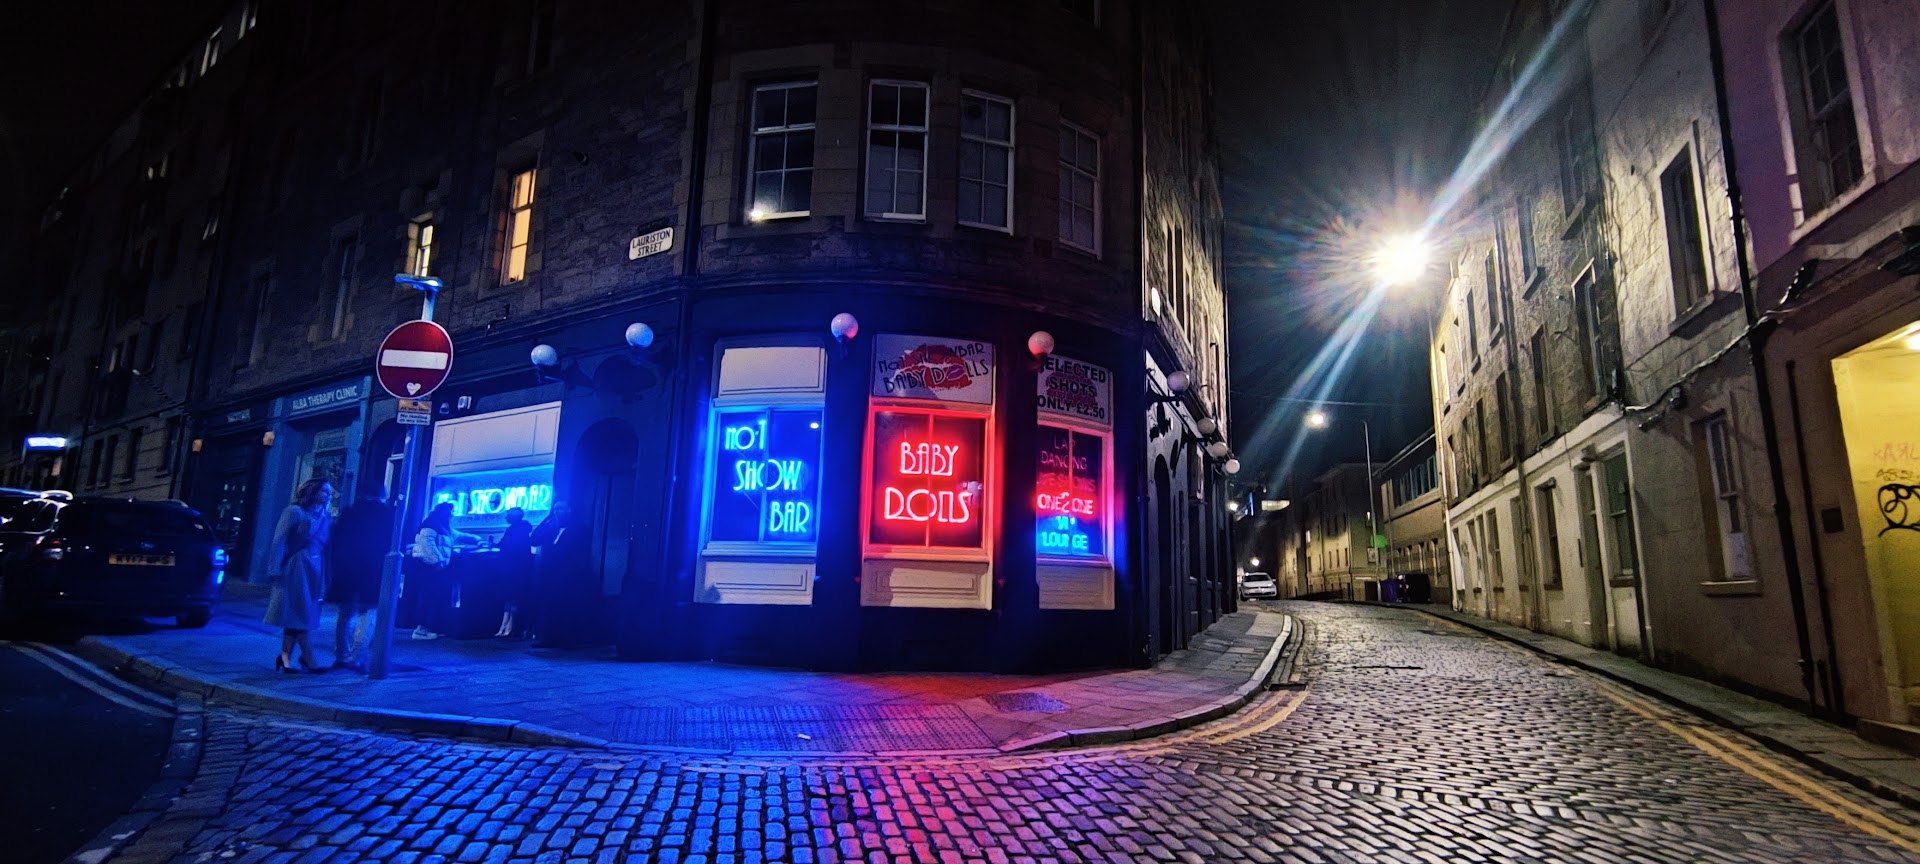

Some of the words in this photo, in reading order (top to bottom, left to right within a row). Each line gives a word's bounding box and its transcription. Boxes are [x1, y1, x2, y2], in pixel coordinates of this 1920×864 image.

[632, 229, 671, 249] LAURISTON
[638, 241, 663, 257] STREET
[883, 369, 926, 393] BABY
[1045, 356, 1107, 383] ELECTED
[293, 398, 308, 410] ALBA
[308, 391, 335, 407] THERAPY
[336, 385, 358, 400] CLINIC
[1049, 376, 1098, 399] SHOTS
[1037, 395, 1072, 412] ONLY
[1077, 402, 1105, 419] £2.50
[900, 442, 959, 476] BABY
[1041, 451, 1088, 470] DANCNG
[733, 459, 802, 491] SHOW
[769, 501, 811, 533] BAR
[884, 487, 973, 523] DOLLS
